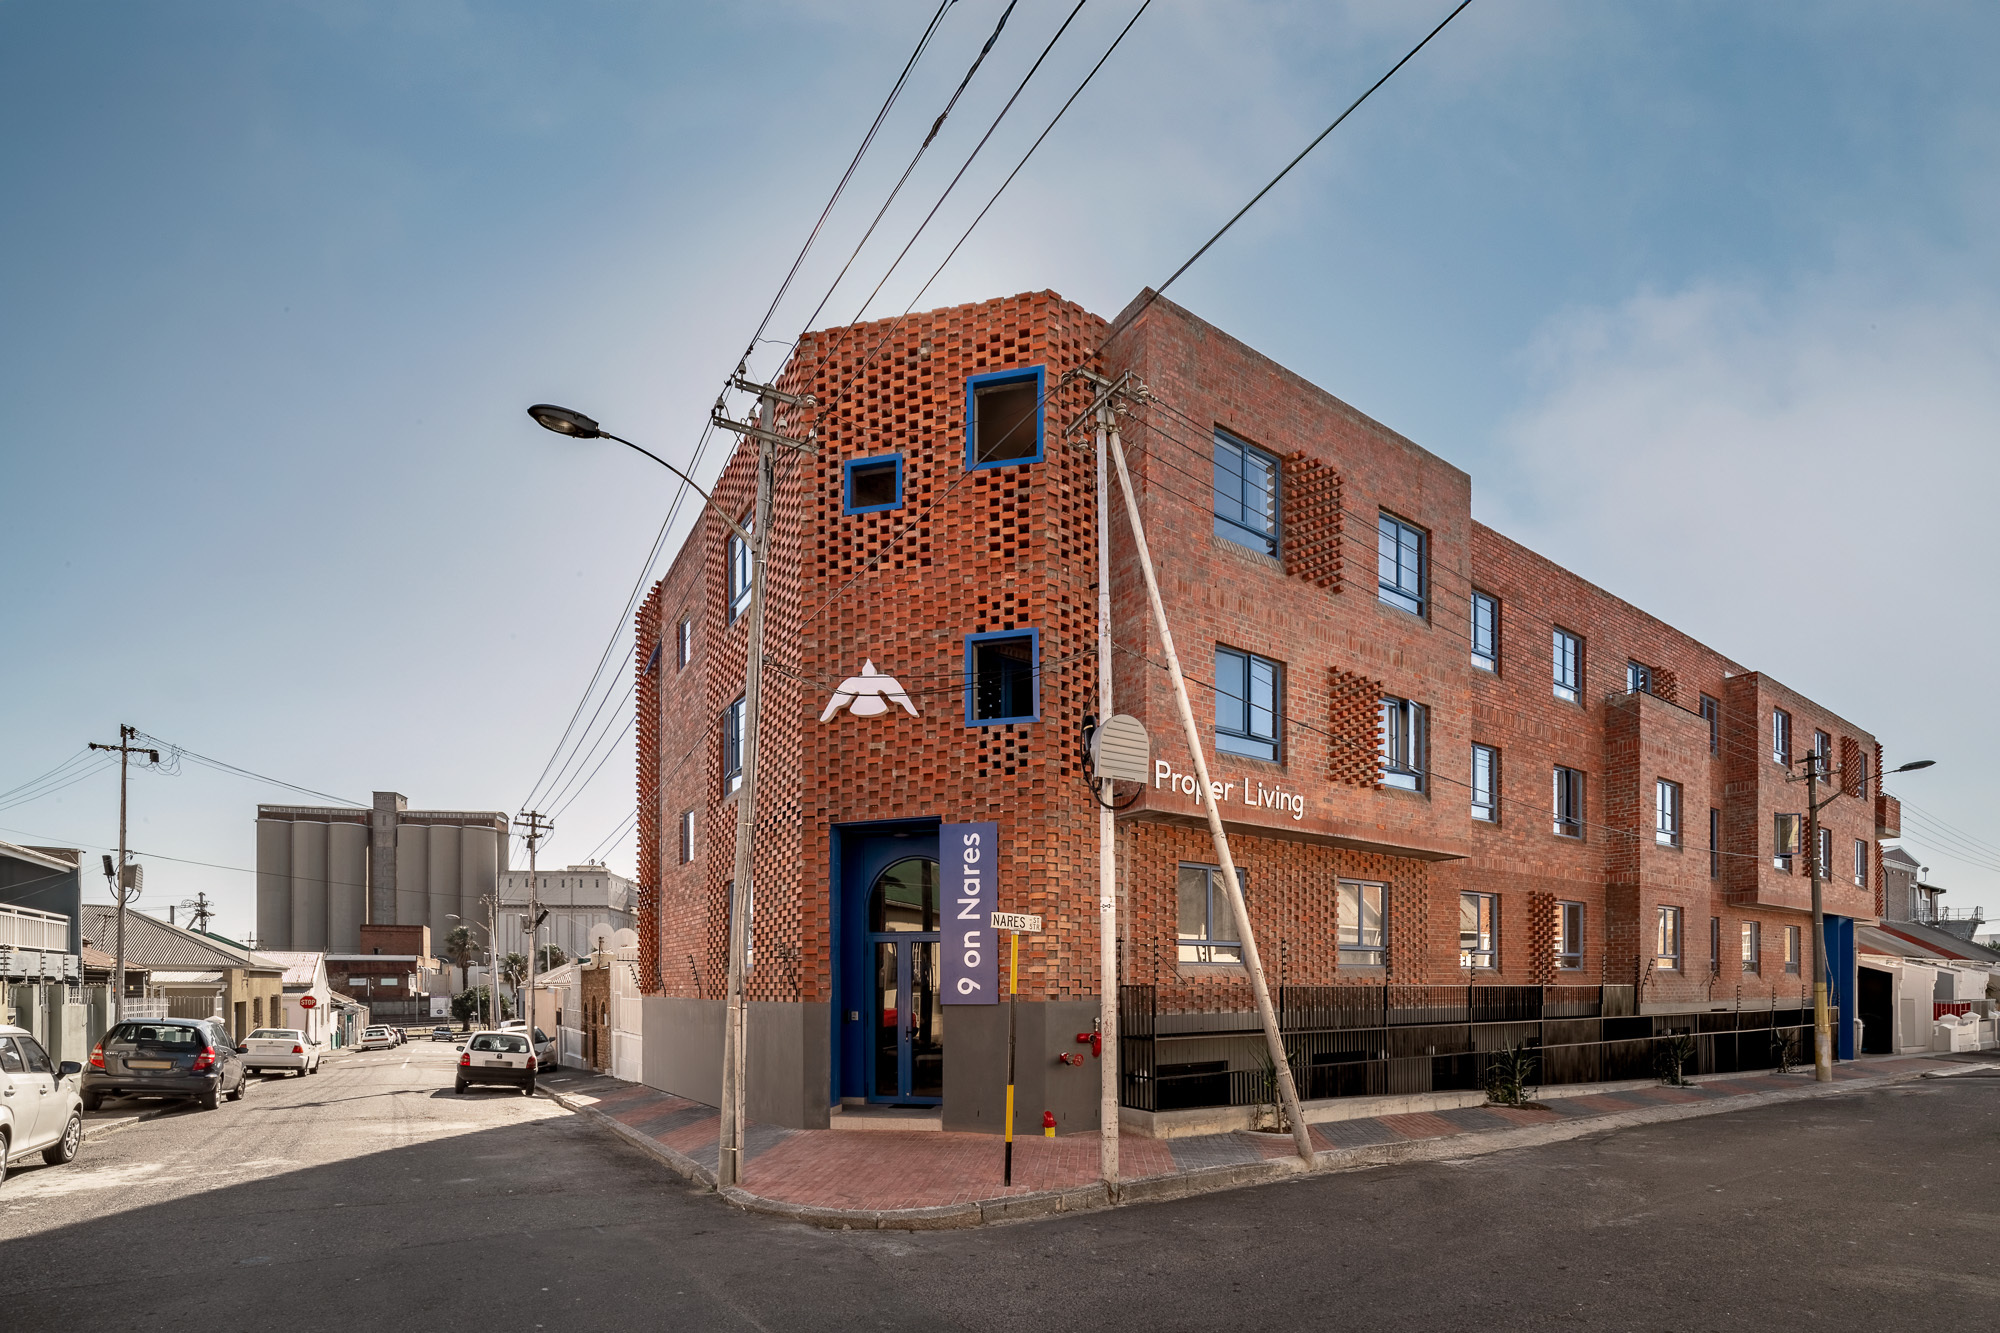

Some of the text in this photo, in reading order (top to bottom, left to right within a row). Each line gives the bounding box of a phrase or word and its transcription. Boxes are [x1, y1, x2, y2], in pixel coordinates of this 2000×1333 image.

[1244, 778, 1304, 820] Living
[957, 832, 981, 995] 9 on Nares
[993, 914, 1026, 929] NARES
